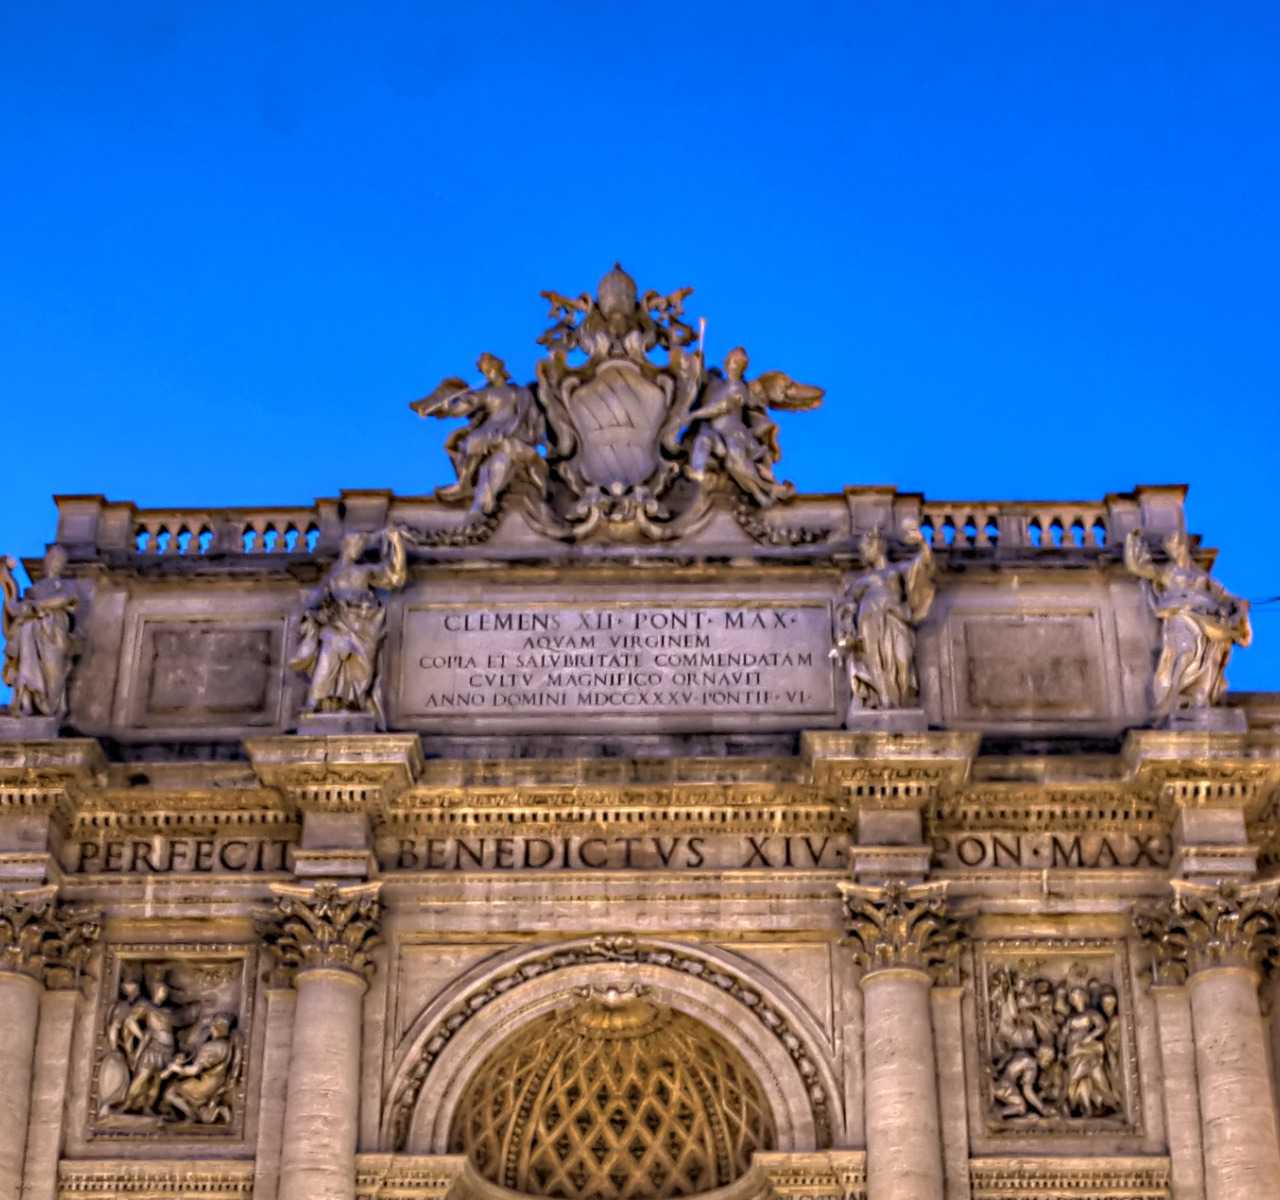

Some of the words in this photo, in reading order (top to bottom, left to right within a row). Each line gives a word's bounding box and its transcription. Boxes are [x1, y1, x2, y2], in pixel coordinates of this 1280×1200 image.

[444, 612, 561, 632] CLEMENS
[522, 635, 596, 653] AQVAM
[610, 634, 711, 649] VIRGINEM
[487, 654, 506, 669] ET
[653, 652, 813, 668] COMMENDATAM
[469, 673, 534, 688] CVLTV
[546, 672, 663, 688] MAGNIFICO
[671, 671, 761, 687] ORNAVIT
[425, 693, 486, 708] ANNO
[492, 692, 567, 707] DOMINI
[75, 840, 295, 874] PERFECIT
[395, 837, 706, 870] BENEDICTVS
